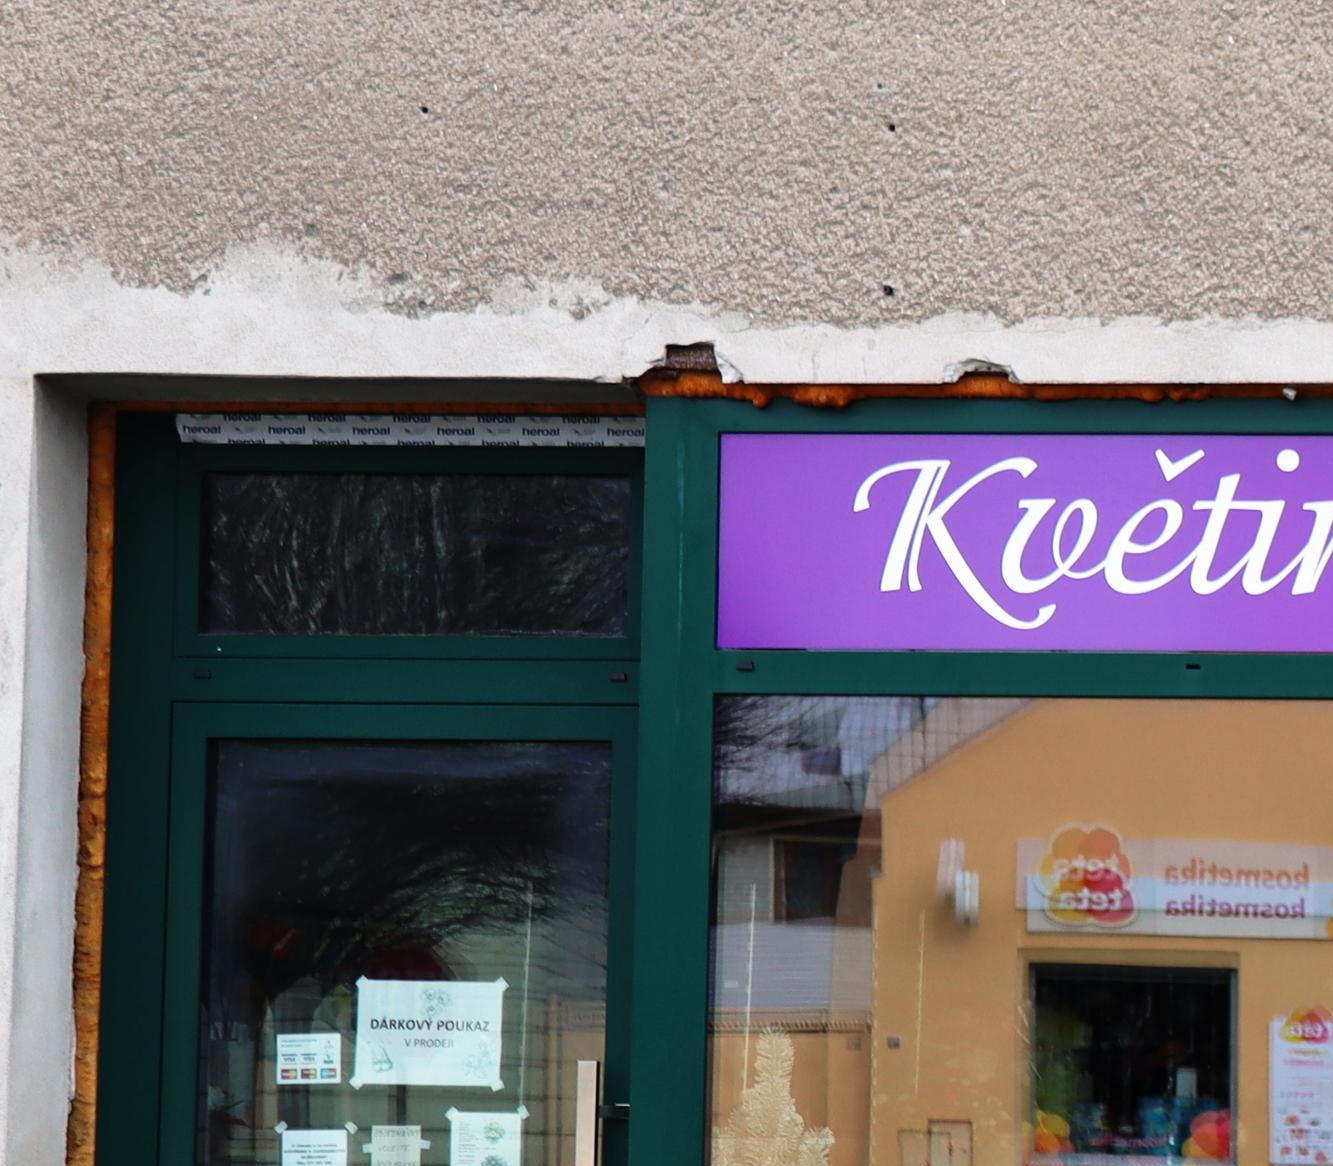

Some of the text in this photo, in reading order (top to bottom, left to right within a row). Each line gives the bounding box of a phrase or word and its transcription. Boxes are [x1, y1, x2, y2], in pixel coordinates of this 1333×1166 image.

[183, 425, 221, 434] heroal
[268, 425, 306, 435] heroal
[352, 426, 391, 436] heroal
[437, 426, 475, 436] heroal
[522, 427, 560, 437] heroal
[607, 427, 645, 437] heroal
[370, 1016, 490, 1032] DÁRKOVÝ POUKAZ
[404, 1039, 411, 1047] V
